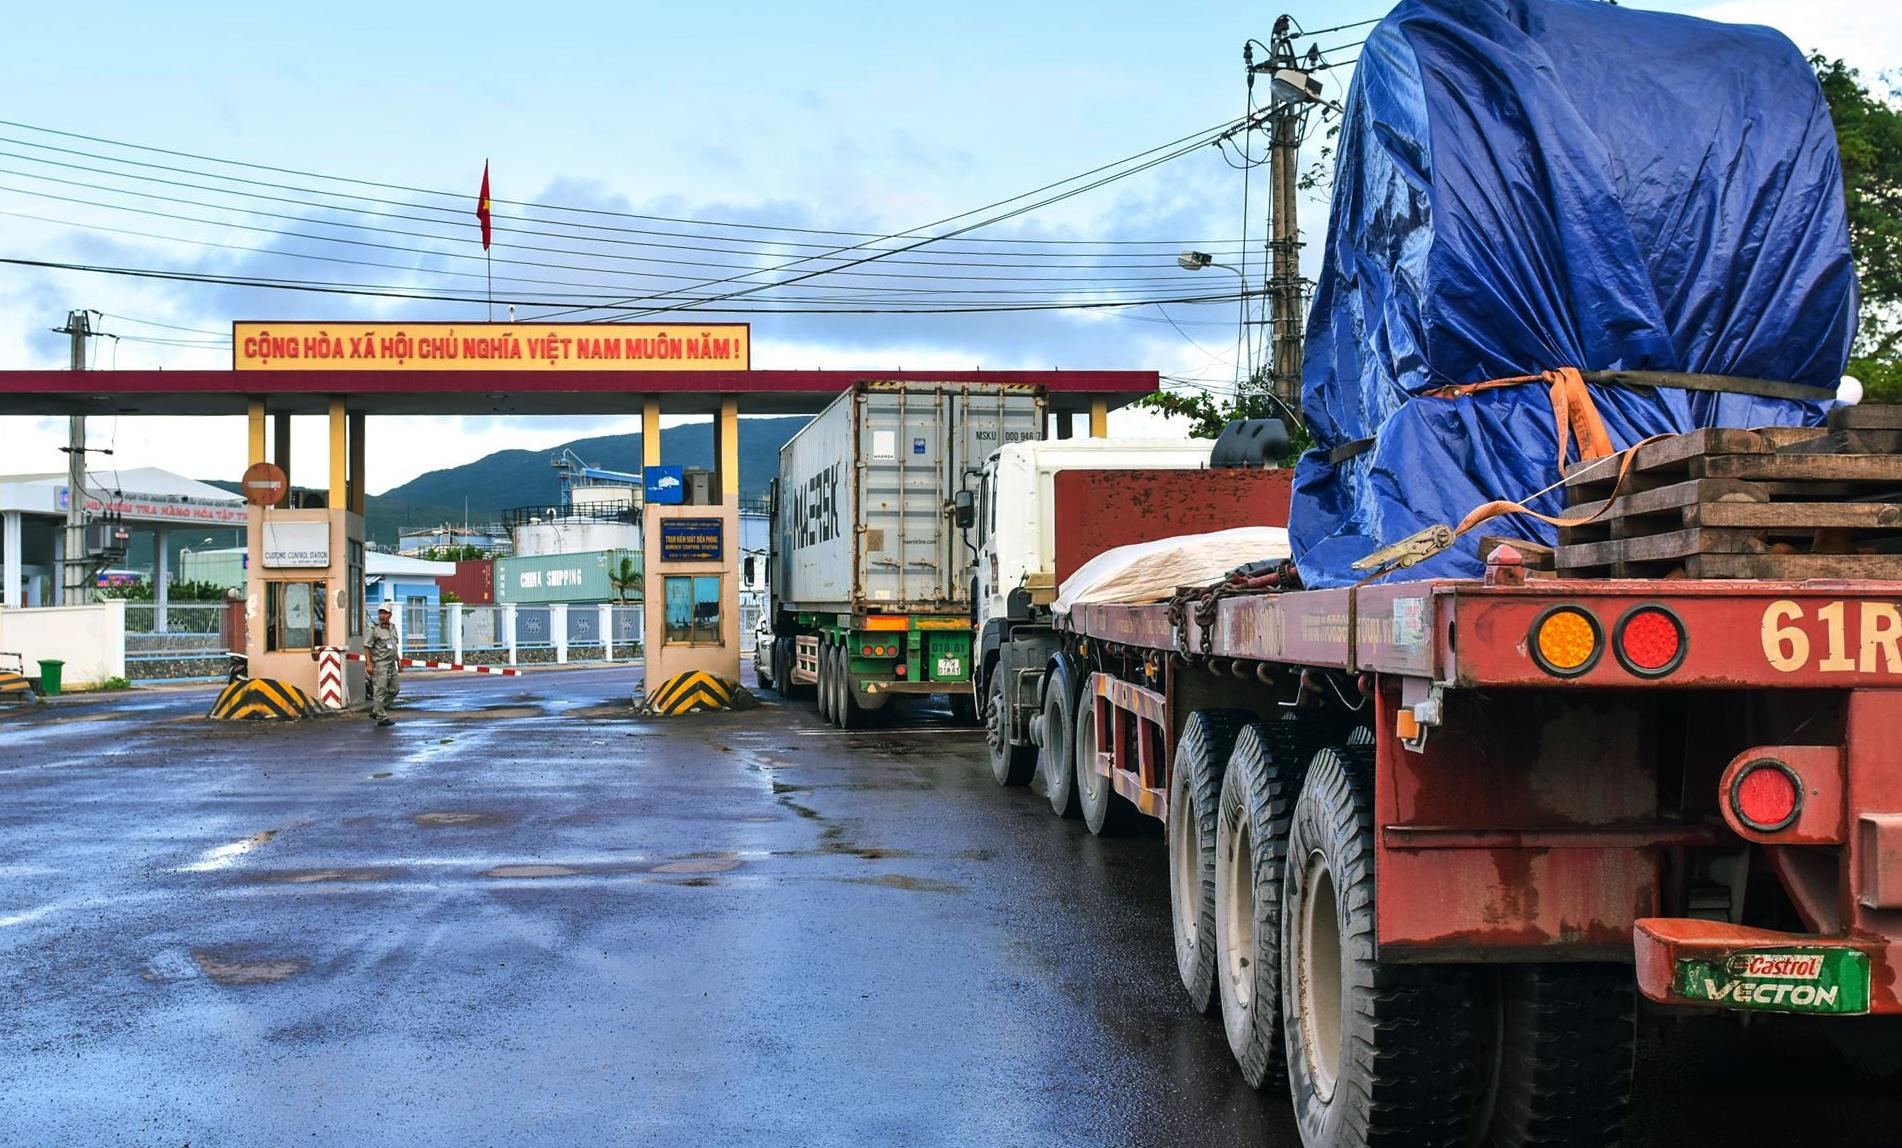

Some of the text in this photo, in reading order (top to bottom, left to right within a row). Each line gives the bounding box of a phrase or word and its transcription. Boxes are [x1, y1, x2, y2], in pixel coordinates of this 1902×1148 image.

[244, 331, 299, 365] CỘNG
[304, 331, 344, 359] HÒA
[350, 331, 376, 359] XÃ
[381, 331, 413, 365] HỘI
[418, 328, 458, 359] CHỦ
[463, 332, 521, 359] NGHĨA
[528, 332, 572, 366] VIỆT
[577, 338, 621, 359] NAM
[626, 332, 682, 359] MUÔN
[976, 431, 996, 440] MSKU
[1005, 431, 1019, 441] 000
[793, 460, 840, 551] MAERSK
[287, 552, 308, 560] CONTROL
[520, 571, 542, 588] CHINA
[546, 568, 582, 587] SHIPPING
[1761, 600, 1902, 674] 61R
[1749, 956, 1817, 977] Castrol
[1703, 977, 1839, 1006] VECTON
